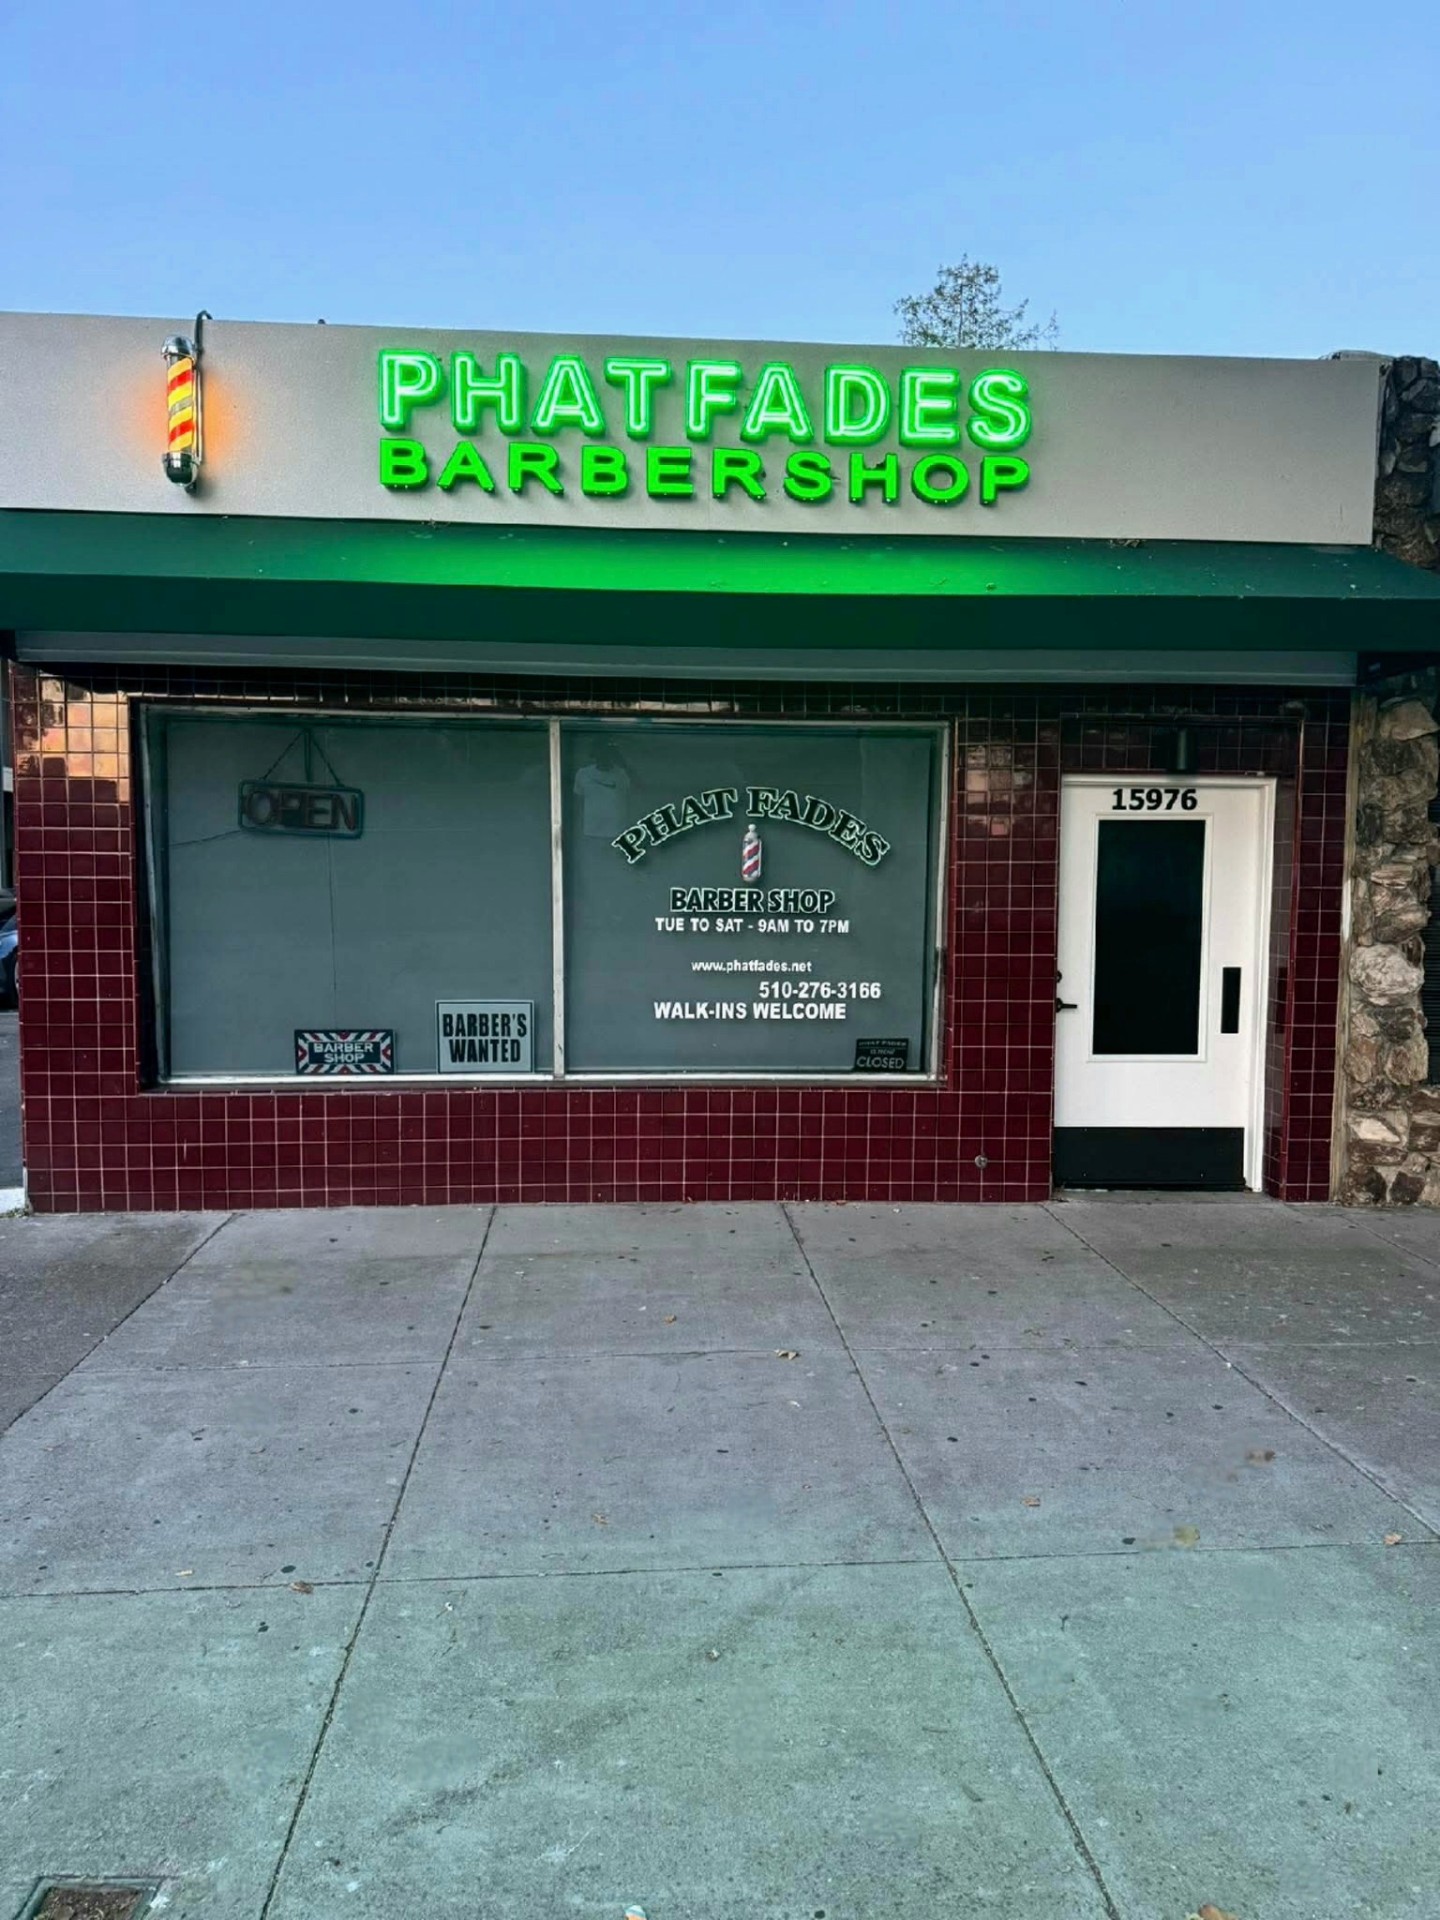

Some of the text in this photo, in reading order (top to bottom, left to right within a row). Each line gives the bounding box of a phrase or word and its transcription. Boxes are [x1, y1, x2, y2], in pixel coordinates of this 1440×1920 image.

[379, 438, 1031, 505] BARBERSHOP
[1112, 788, 1198, 811] 15976
[244, 791, 357, 831] OPEN
[611, 787, 891, 866] PHAT FADES
[670, 887, 835, 913] BARBER SHOP
[655, 917, 685, 932] TUE
[690, 918, 710, 932] TO
[715, 918, 744, 933] SAT
[757, 919, 790, 933] 9AM
[794, 919, 814, 933] TO
[820, 920, 850, 934] 7PM
[691, 960, 812, 973] www.phatfades.net
[758, 981, 882, 999] 510-276-3166
[654, 1001, 847, 1020] WALK-INS WELCOME
[443, 1013, 527, 1037] BARBER'S
[313, 1043, 374, 1053] BARBER
[324, 1053, 365, 1063] SHOP
[449, 1039, 521, 1063] WANTED
[856, 1056, 905, 1069] CLOSED
